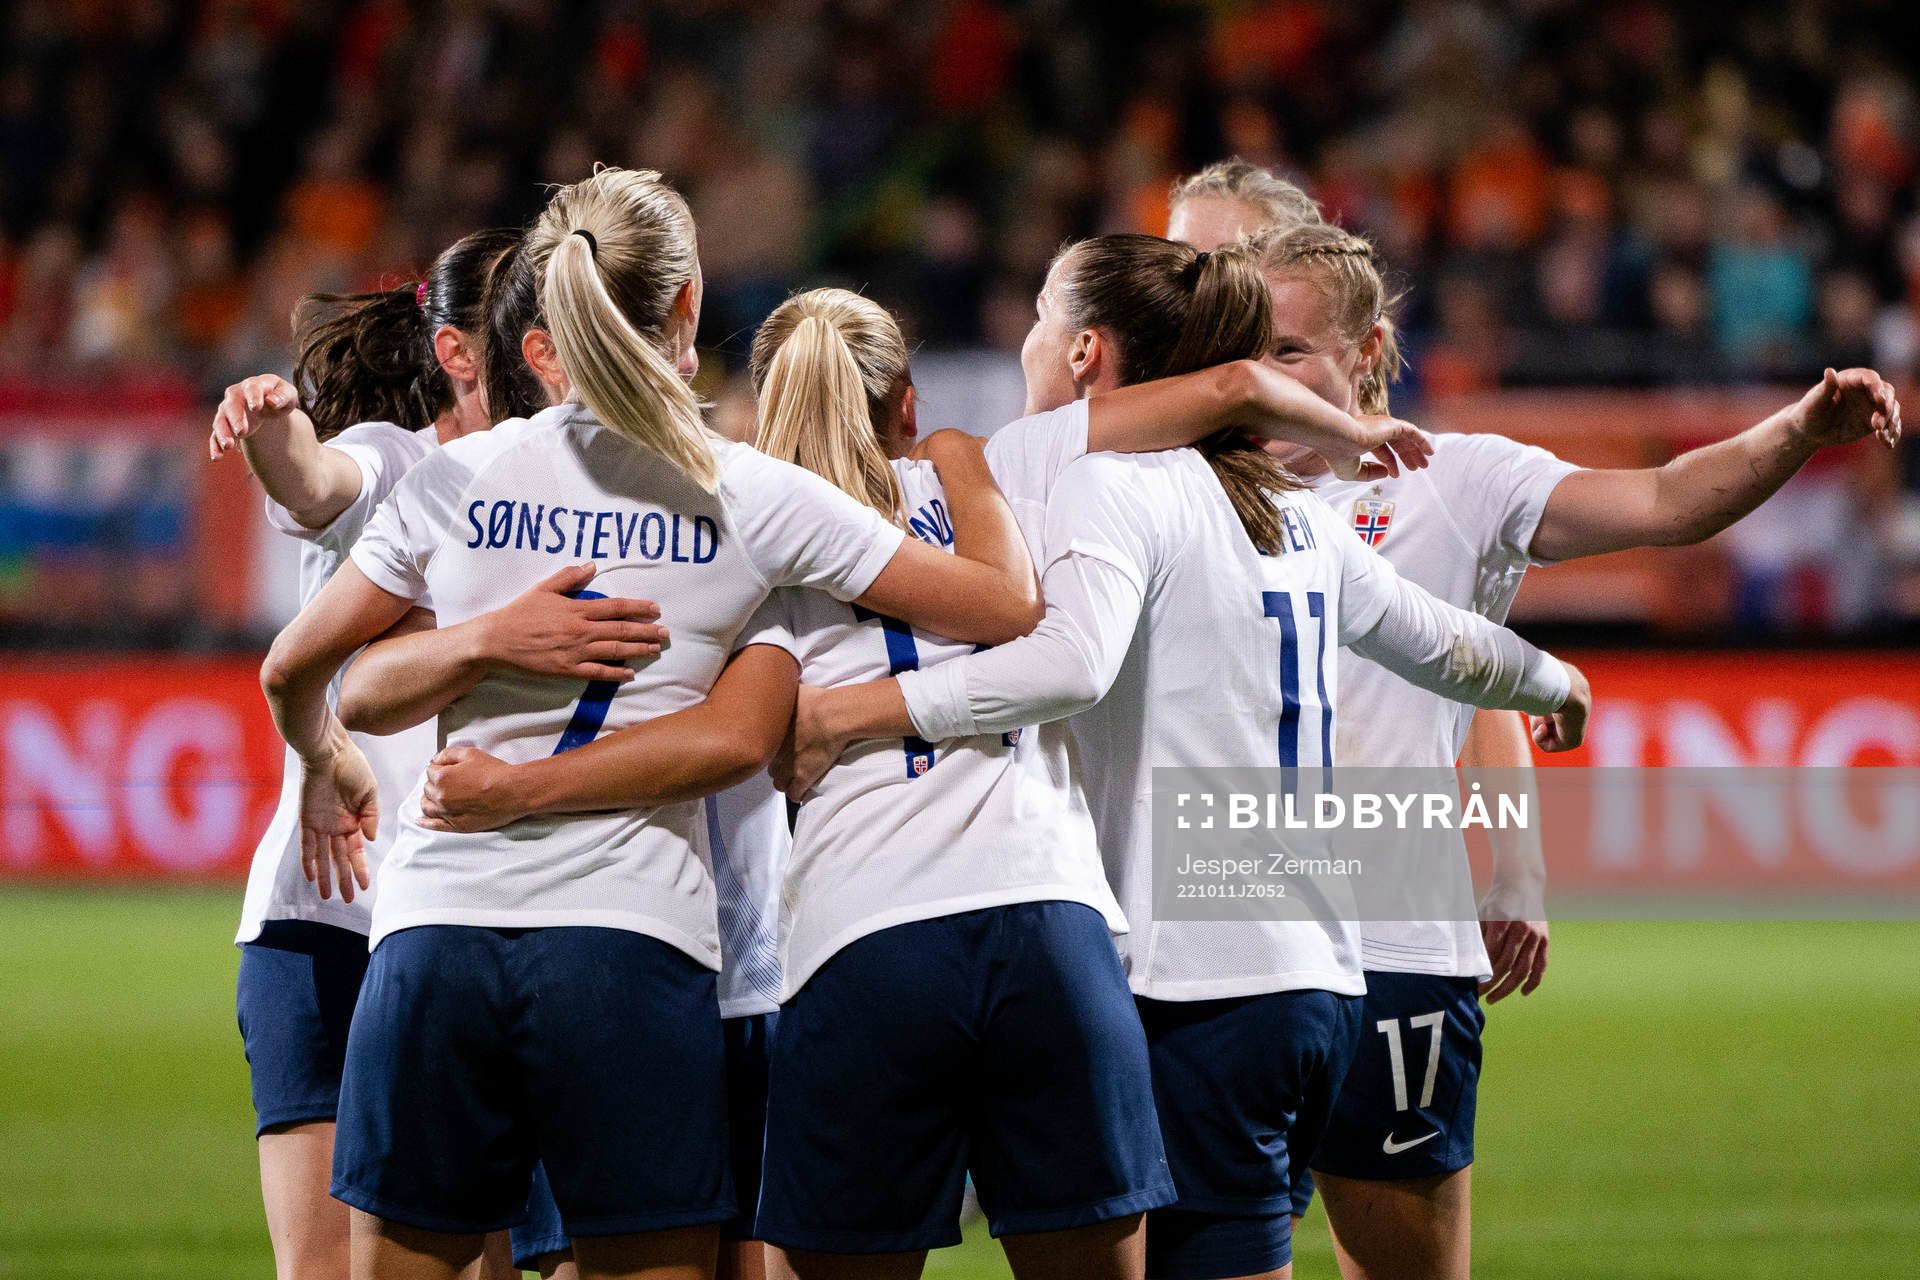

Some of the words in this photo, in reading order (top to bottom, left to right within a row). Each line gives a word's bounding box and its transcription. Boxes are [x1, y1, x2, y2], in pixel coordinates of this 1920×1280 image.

[467, 500, 718, 564] SØNSTEVOLD
[1262, 591, 1333, 816] 11
[1590, 699, 1920, 874] ING
[1376, 1010, 1445, 1111] 17
